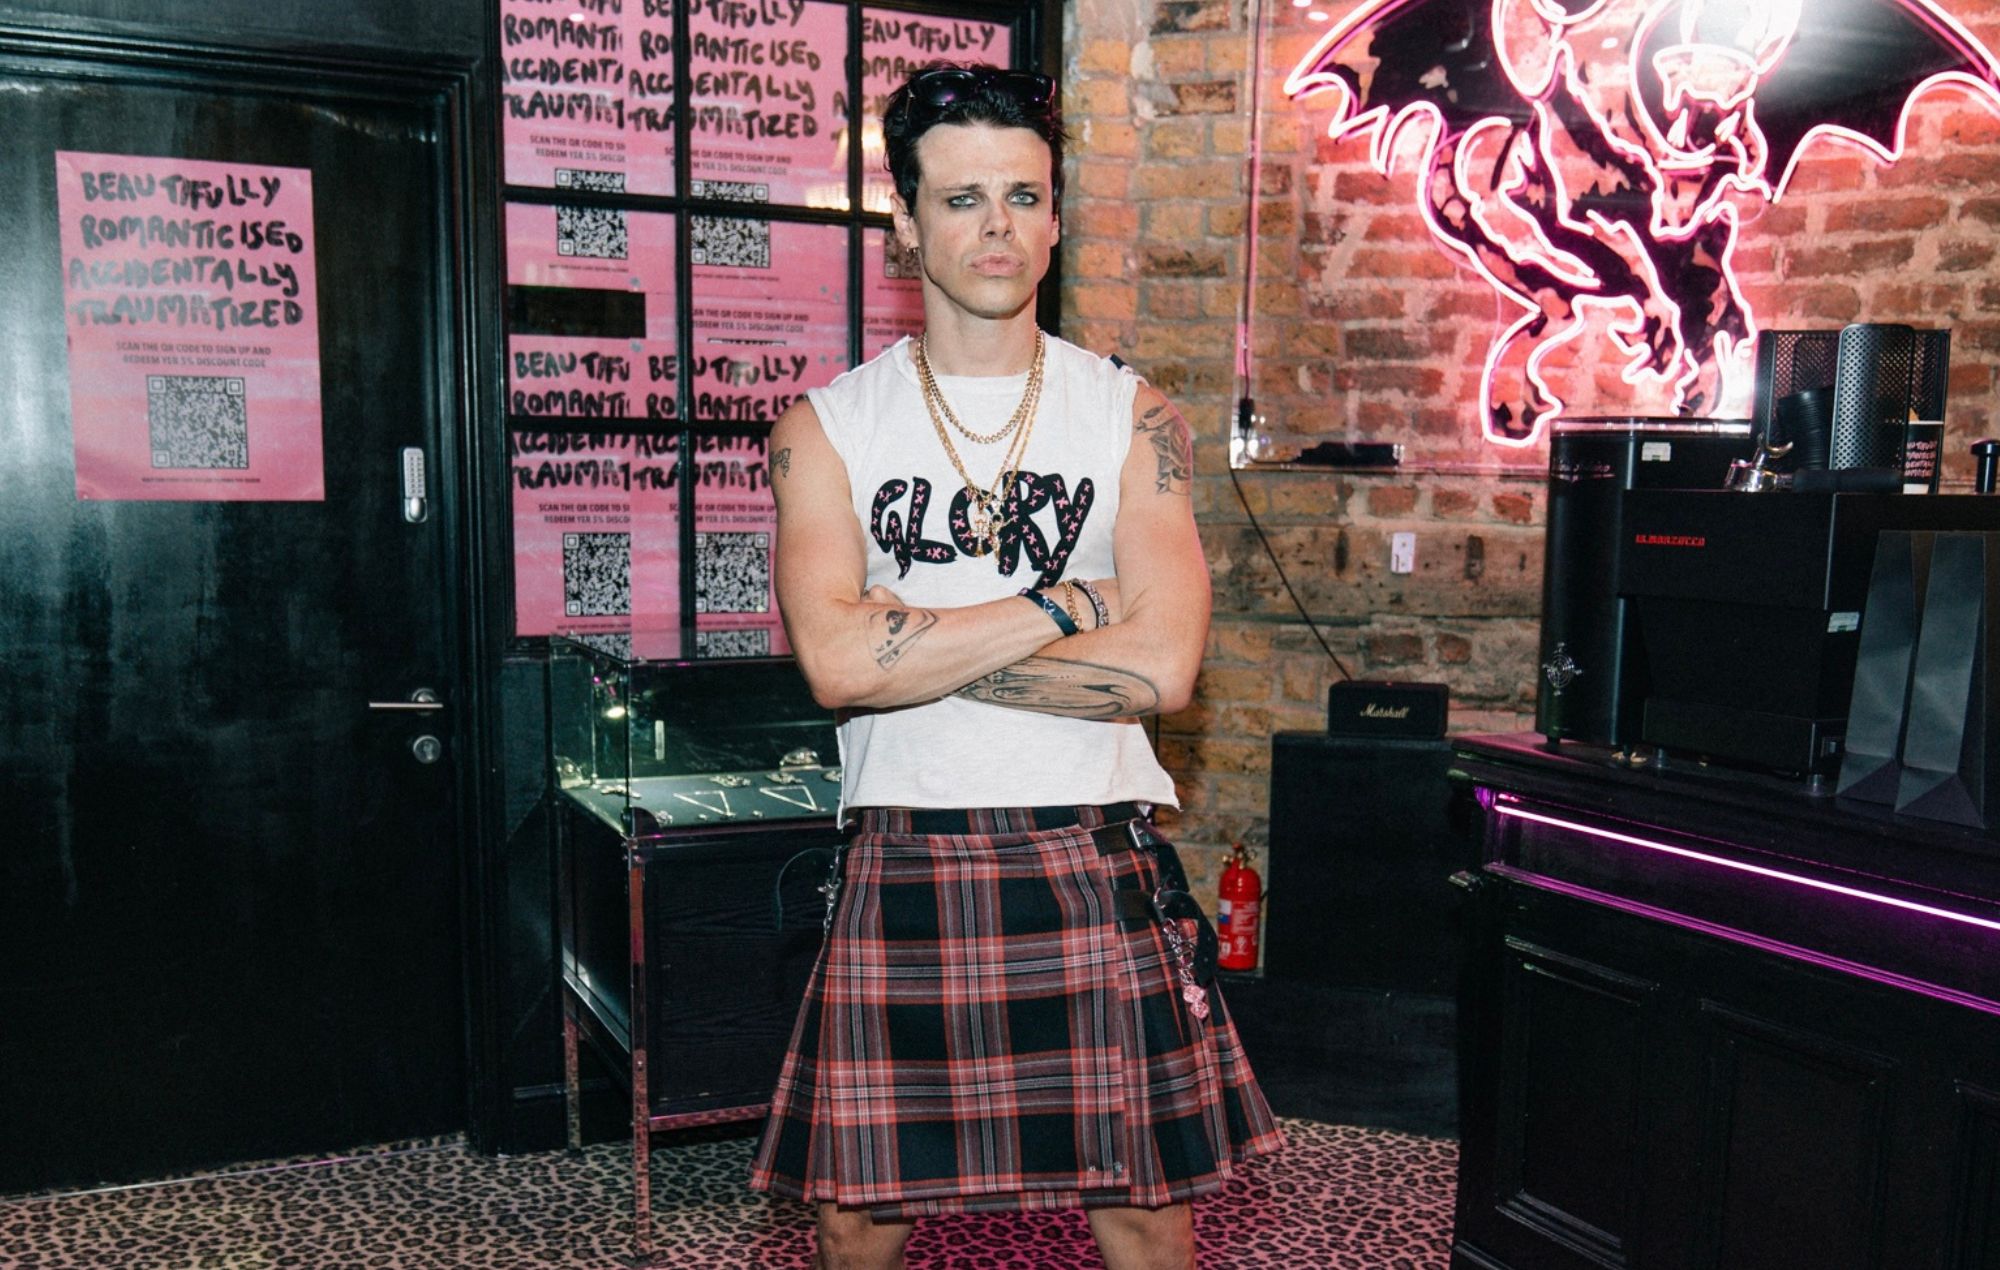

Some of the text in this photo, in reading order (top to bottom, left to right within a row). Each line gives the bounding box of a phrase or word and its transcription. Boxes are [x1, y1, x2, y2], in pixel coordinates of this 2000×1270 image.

[640, 31, 821, 71] ROANTICISED
[863, 17, 995, 53] EAUTIFULLY
[629, 69, 816, 112] ACCENTALLY
[552, 138, 567, 146] THE
[81, 171, 281, 211] BEAUTIFULLY
[80, 214, 303, 253] ROMANTICISED
[69, 256, 299, 298] ACCIDENTALLY
[70, 294, 304, 331] TRAUMATIZED
[116, 341, 140, 351] SCAN
[142, 342, 158, 351] THE
[175, 344, 200, 353] CODE
[202, 345, 213, 354] TO
[215, 345, 237, 354] SIGN
[238, 346, 250, 355] UP
[252, 347, 272, 356] AND
[123, 354, 160, 364] REDEEM
[196, 358, 240, 367] DISCOUNT
[242, 359, 265, 368] CODE
[649, 355, 808, 387] BEUTIFULLY
[539, 503, 559, 511] SCAN
[589, 504, 608, 512] CODE
[870, 470, 1095, 589] GLORY
[1360, 703, 1410, 718] Marshall
